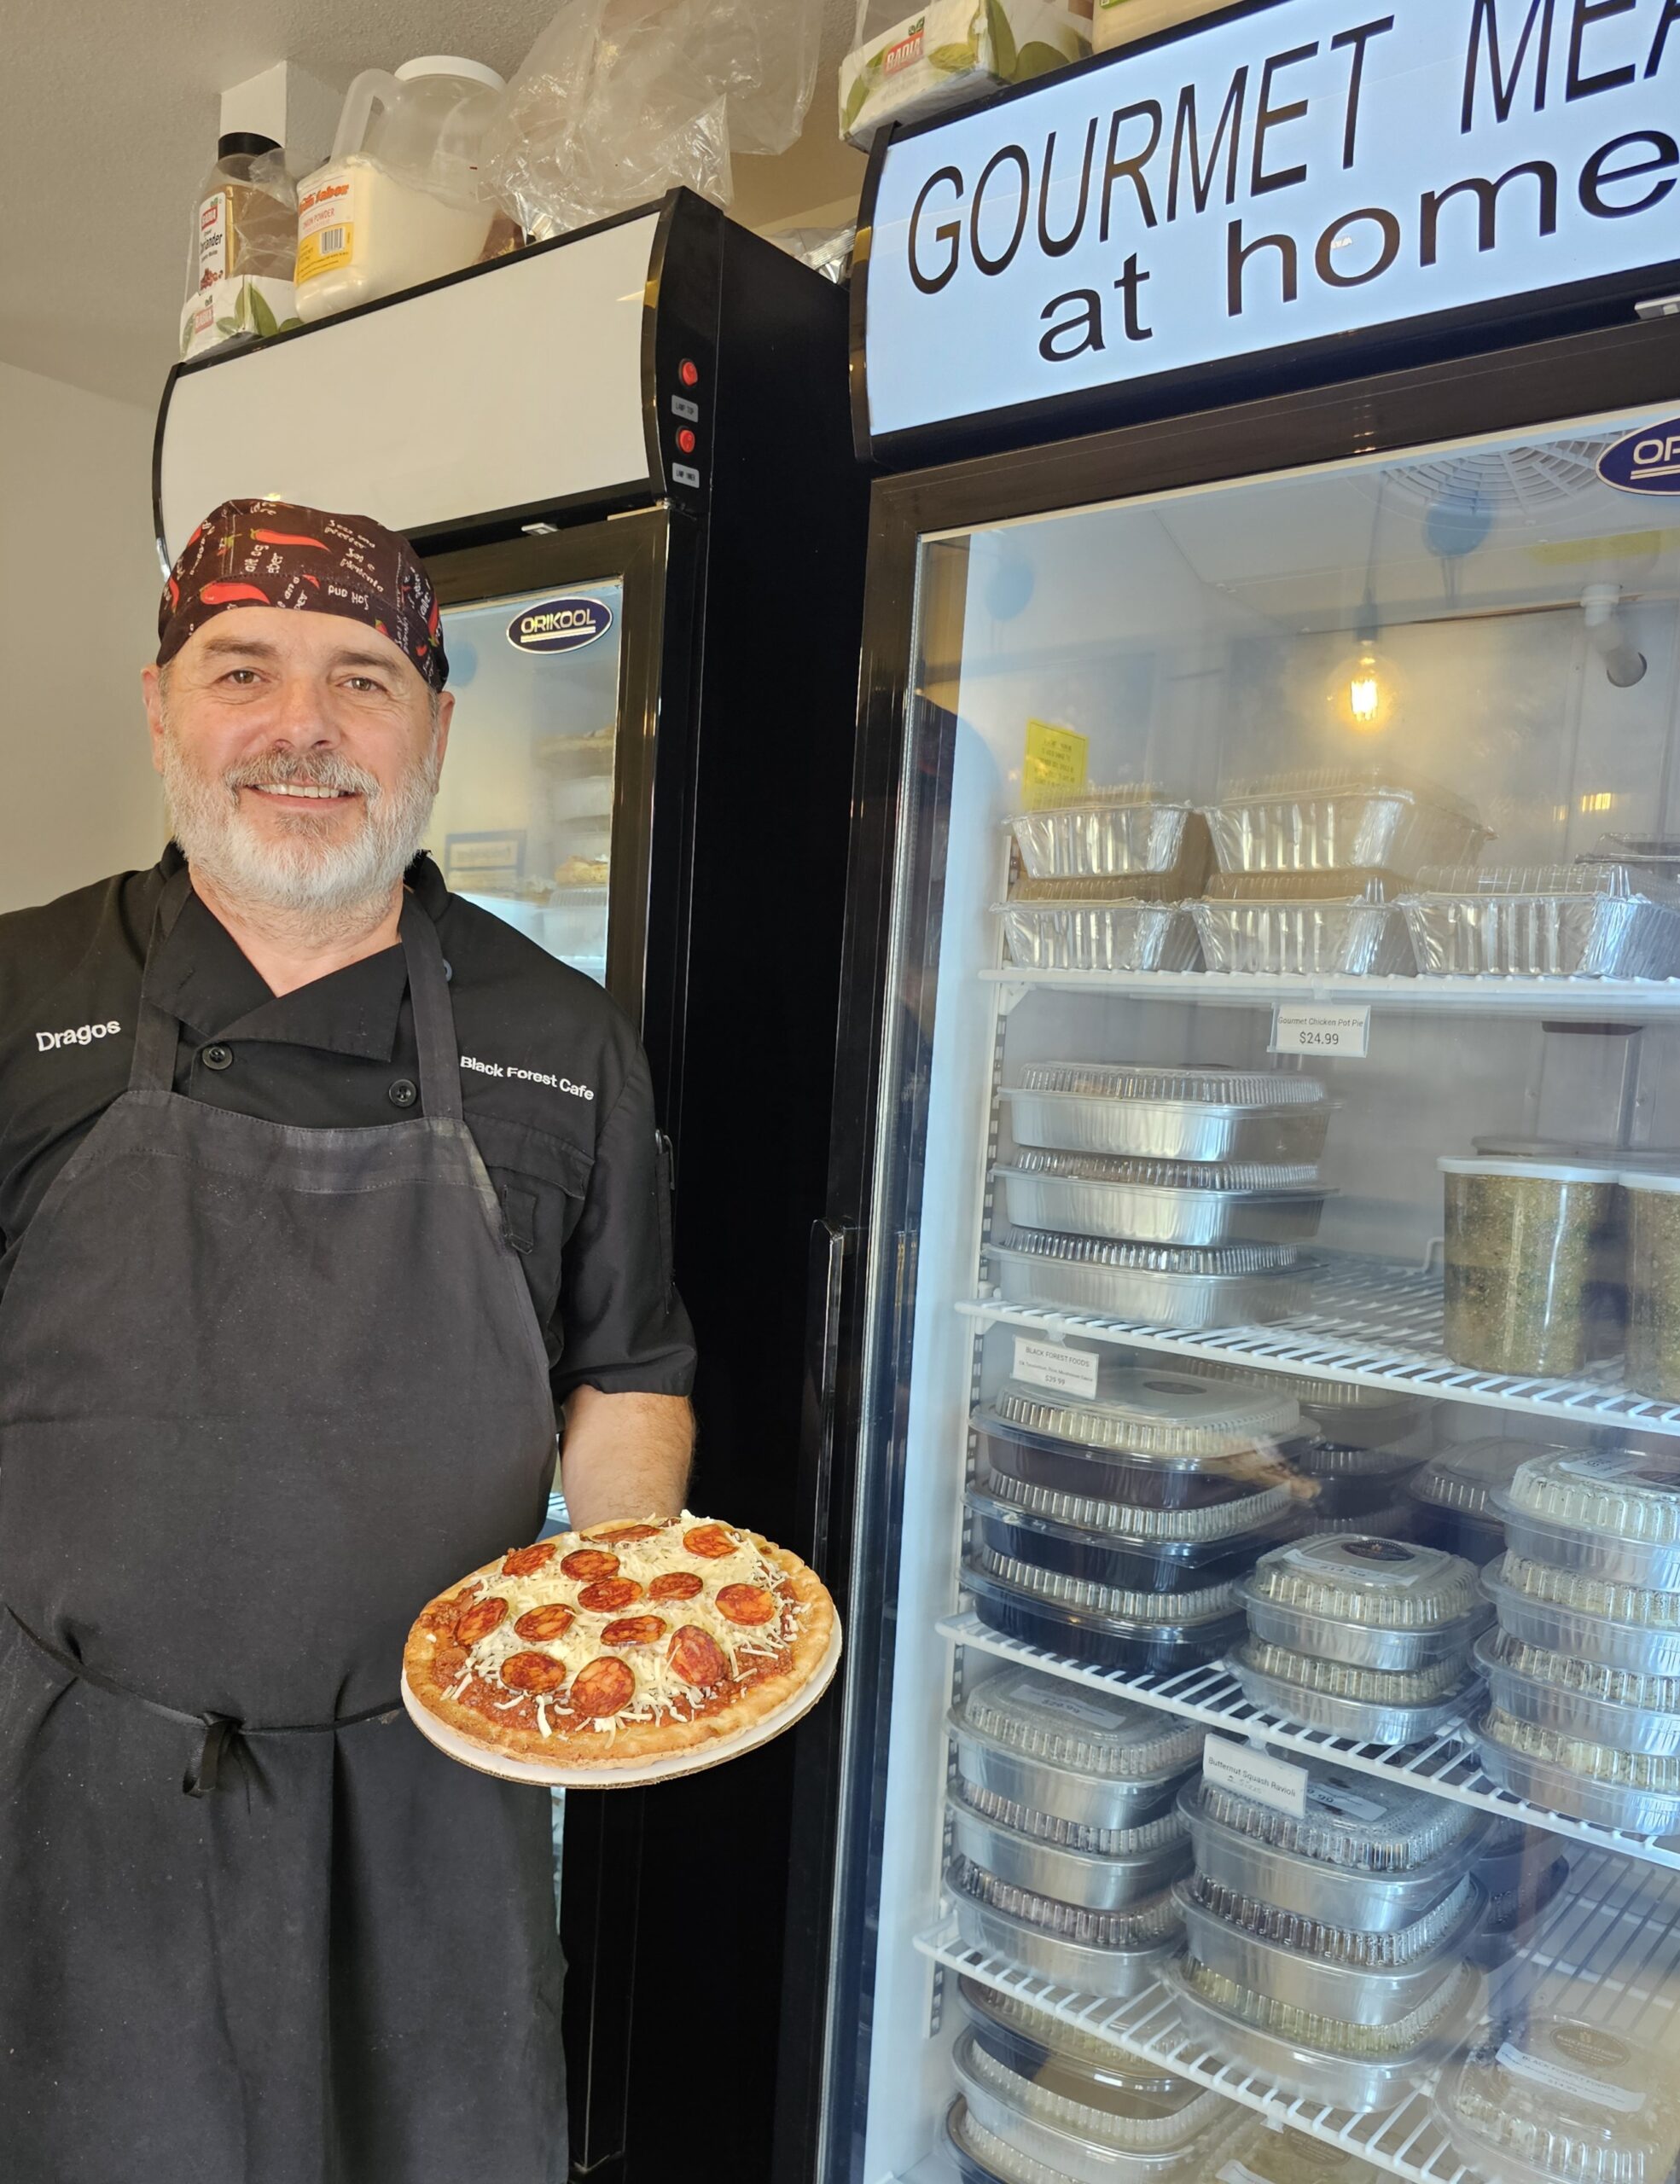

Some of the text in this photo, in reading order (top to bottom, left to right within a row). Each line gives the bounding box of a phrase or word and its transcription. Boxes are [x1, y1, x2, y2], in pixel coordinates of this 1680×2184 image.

[908, 15, 1394, 294] GOURMET
[1038, 130, 1680, 363] at home
[520, 608, 596, 634] ORIKOOL
[35, 1020, 121, 1052] Dragos
[1277, 1016, 1307, 1025] Gourmet
[1352, 1019, 1363, 1027] Pie
[1299, 1030, 1339, 1045] $24.99
[460, 1055, 594, 1101] Black Forest Cafe
[1026, 1346, 1043, 1356] BLACK
[1045, 1351, 1068, 1362] FOREST
[1069, 1356, 1090, 1368] FOODS
[1208, 1756, 1296, 1798] Butternut Squash Ravioli
